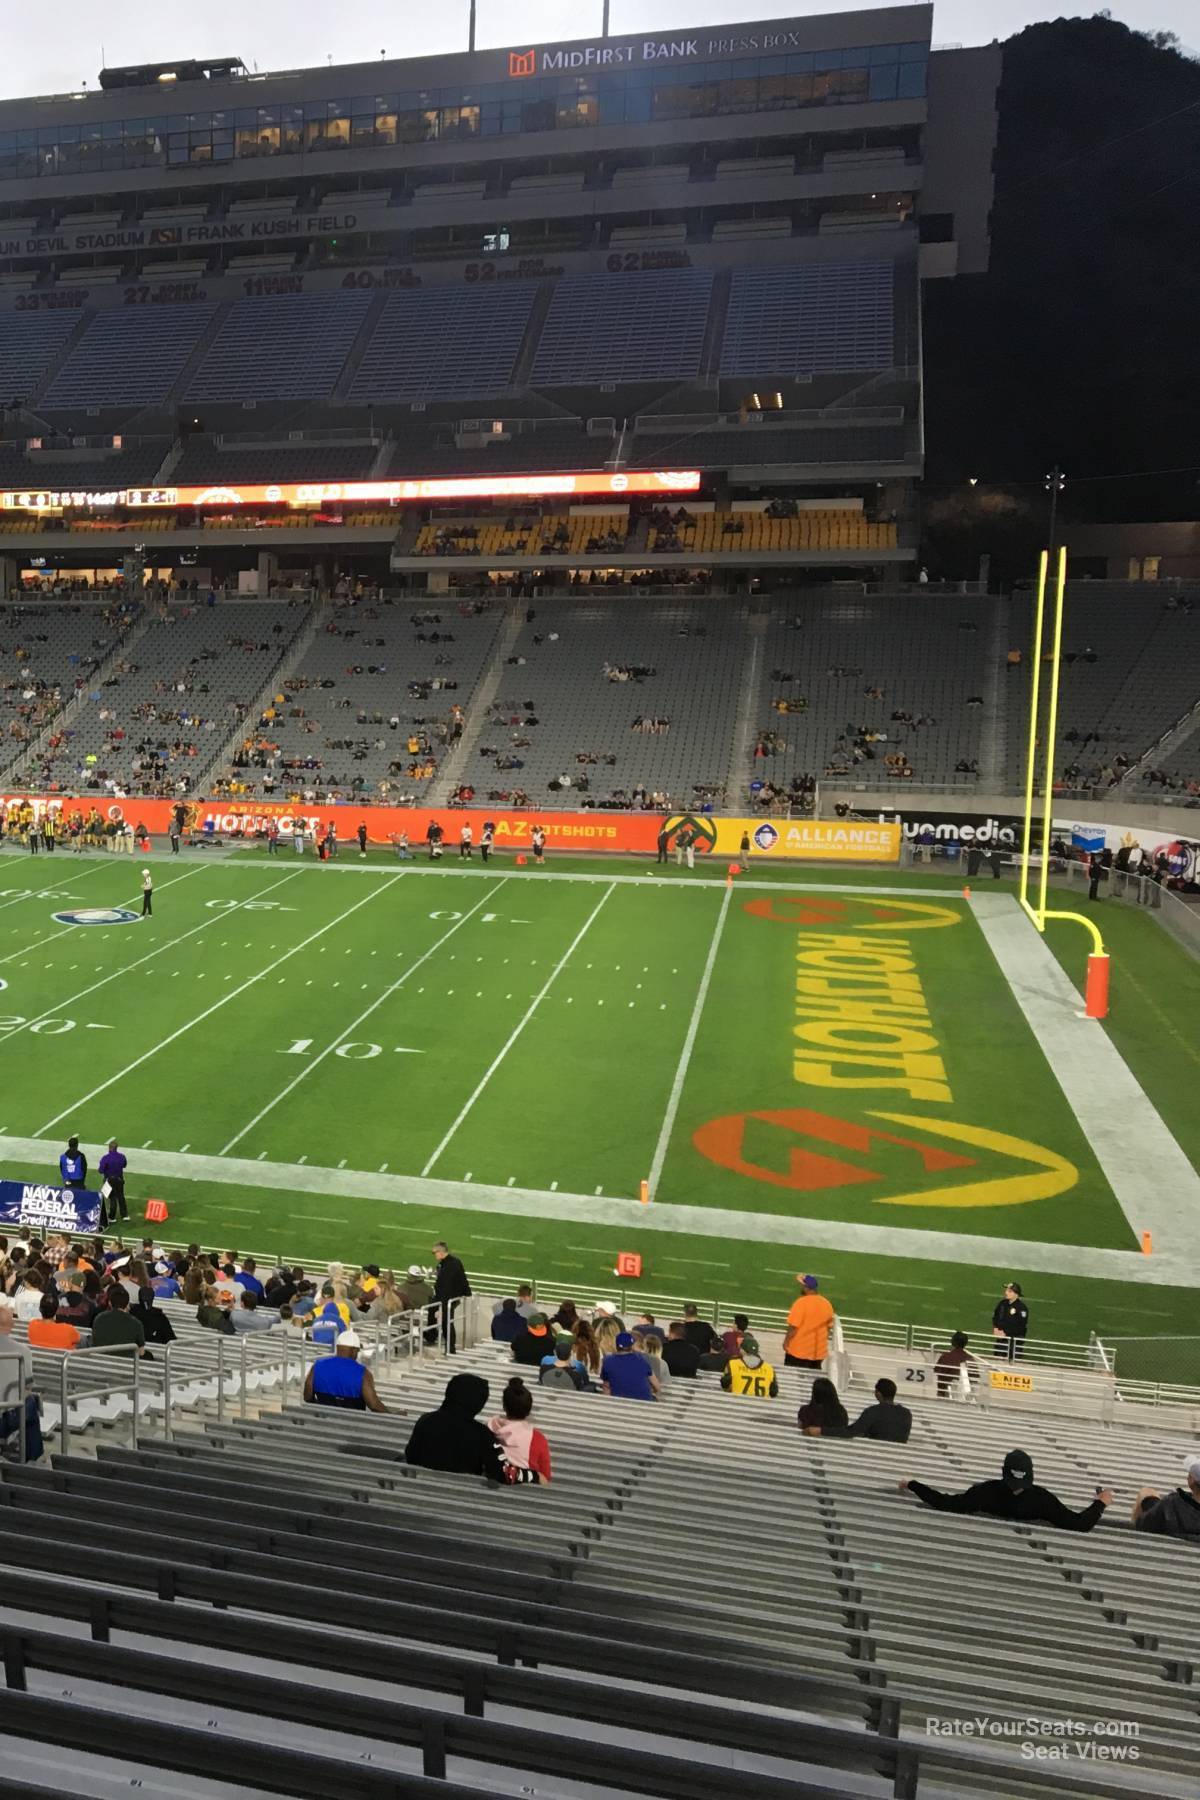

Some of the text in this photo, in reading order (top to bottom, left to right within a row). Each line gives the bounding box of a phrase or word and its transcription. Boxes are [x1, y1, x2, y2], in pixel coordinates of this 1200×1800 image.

[643, 39, 698, 60] BANK
[708, 37, 759, 54] PRESS
[763, 31, 800, 48] BOX
[27, 238, 67, 255] DEVIL
[75, 232, 144, 249] STADIUM
[186, 223, 244, 242] FRANK
[251, 219, 299, 236] KUSH
[307, 214, 357, 233] FIELD
[606, 253, 639, 272] 62
[342, 270, 375, 289] 40
[464, 262, 497, 283] 52
[14, 295, 40, 311] 33
[124, 287, 150, 305] 27
[228, 805, 295, 814] ARIZONA
[786, 827, 892, 844] ALLIANCE
[793, 931, 954, 1103] HOTSHOTS
[275, 1038, 383, 1059] 10
[22, 1186, 60, 1199] NAVY
[21, 1199, 77, 1215] FEDERAL
[148, 1202, 162, 1216] 10
[19, 1213, 77, 1230] Credit Union
[623, 1256, 636, 1274] G
[905, 1368, 926, 1383] 25
[741, 1375, 766, 1397] 76
